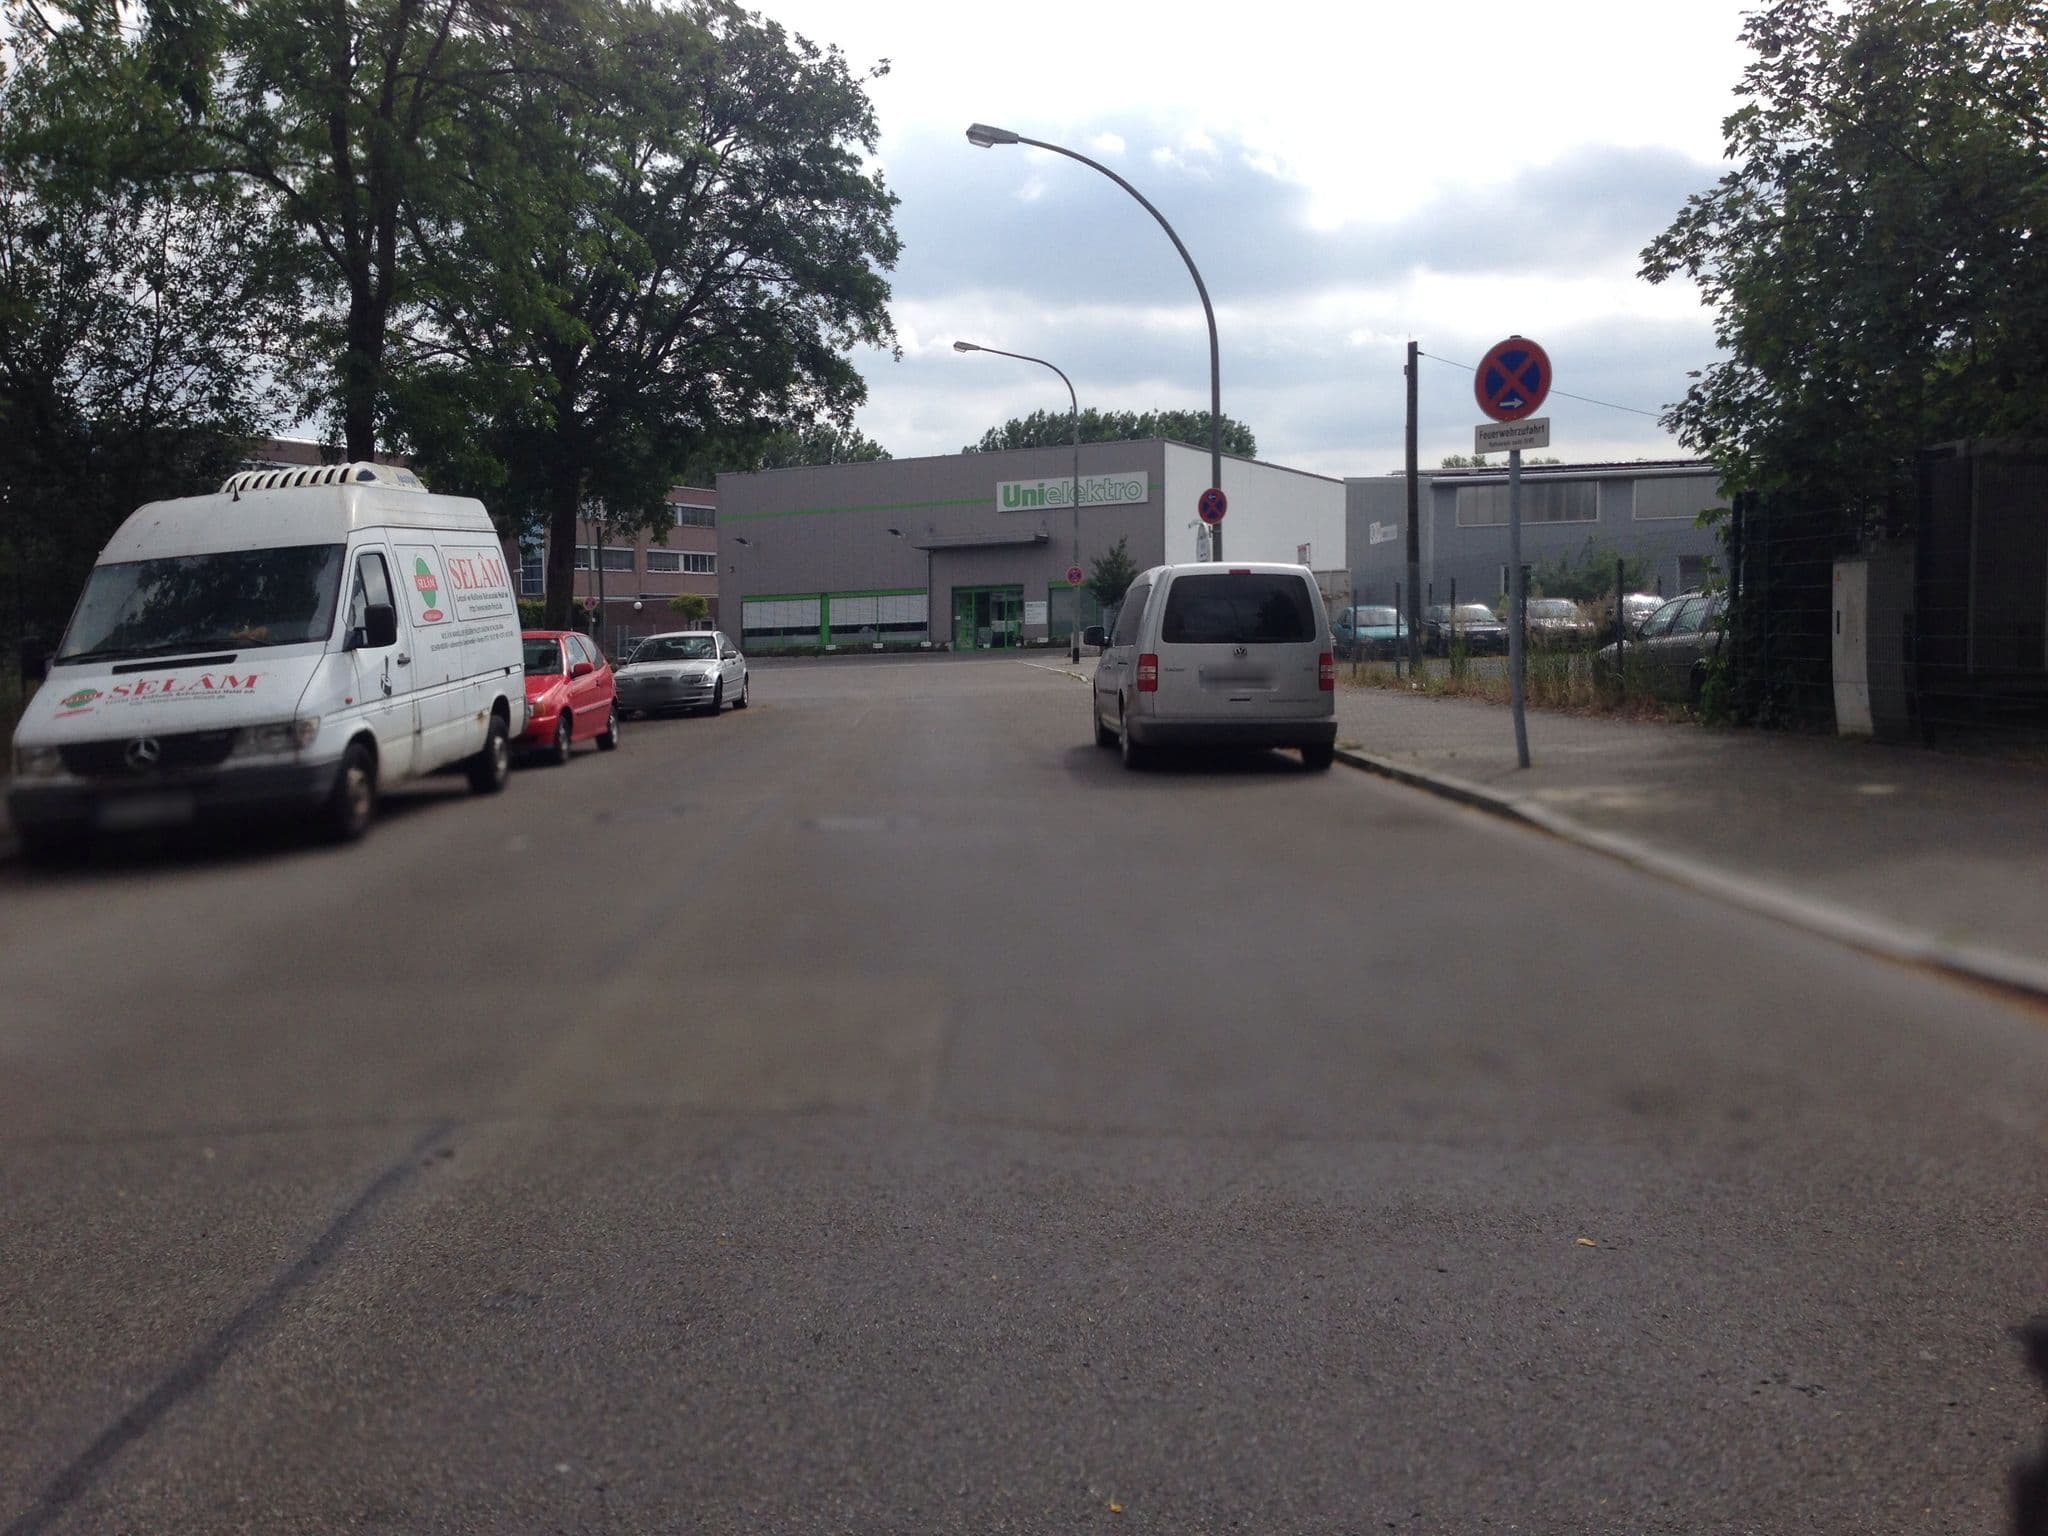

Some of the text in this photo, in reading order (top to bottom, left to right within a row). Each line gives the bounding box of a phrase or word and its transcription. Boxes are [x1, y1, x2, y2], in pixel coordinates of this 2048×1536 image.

[1479, 423, 1545, 440] Feuerwehrzufahrt
[1002, 477, 1143, 508] Unielektro
[448, 552, 505, 589] SELÂM
[110, 673, 260, 698] SELÂM
